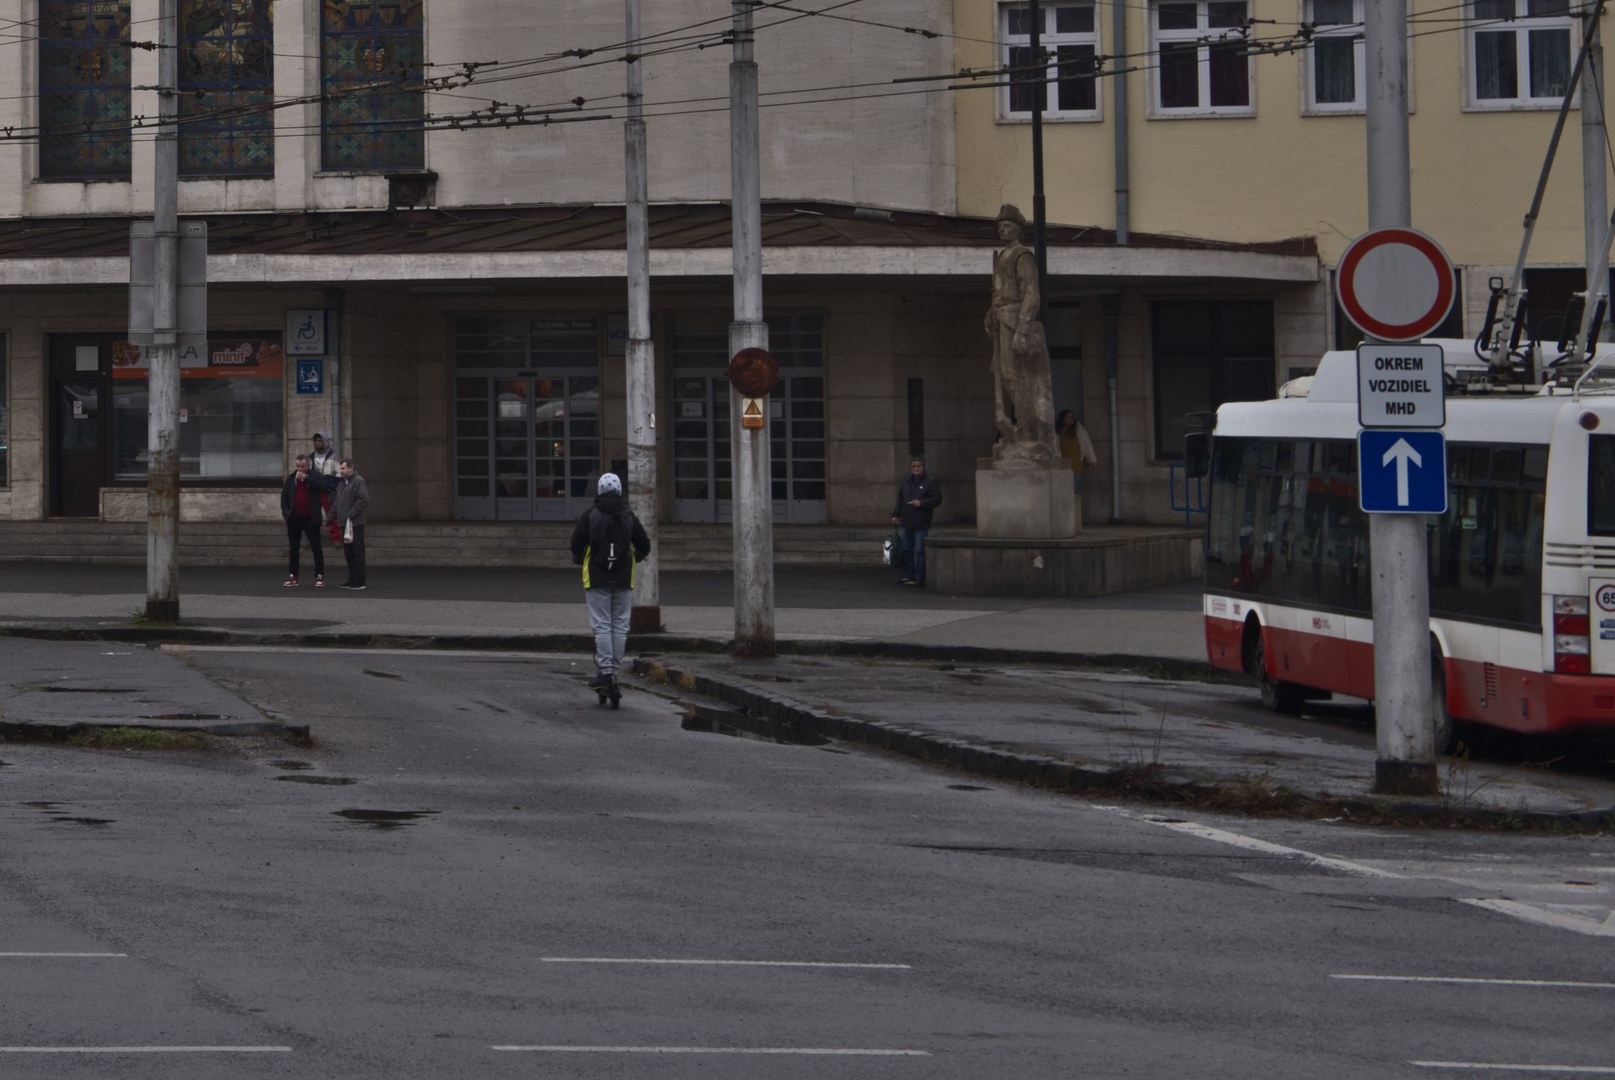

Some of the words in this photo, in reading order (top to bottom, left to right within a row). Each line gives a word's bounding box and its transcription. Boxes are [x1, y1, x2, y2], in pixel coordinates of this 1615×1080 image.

[610, 329, 629, 339] VCH
[1374, 357, 1423, 371] OKREM
[1368, 379, 1431, 392] VOZIDIEL
[1385, 402, 1416, 415] MHD
[1602, 592, 1615, 604] 65
